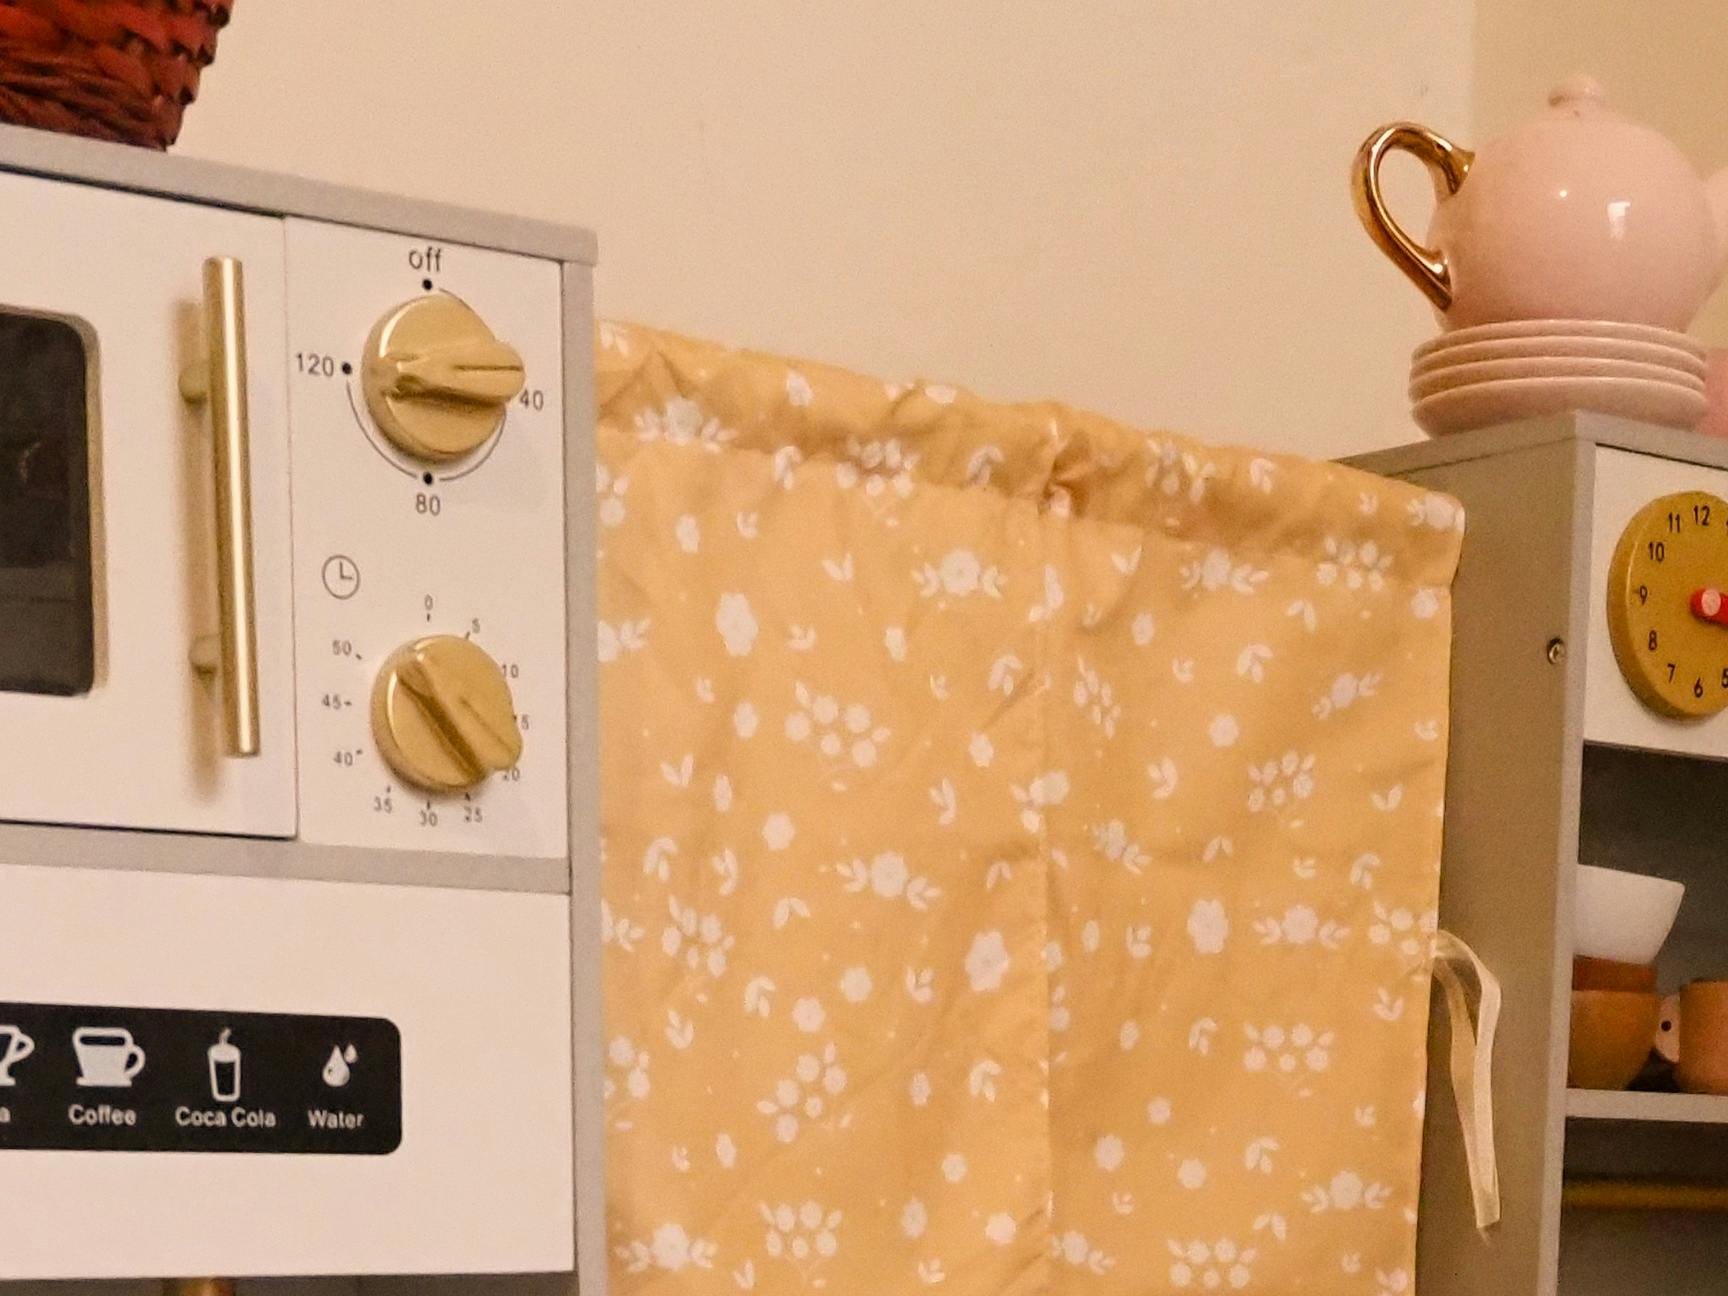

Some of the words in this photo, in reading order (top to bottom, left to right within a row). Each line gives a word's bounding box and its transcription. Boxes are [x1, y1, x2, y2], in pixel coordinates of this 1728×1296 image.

[296, 352, 335, 378] 120
[519, 389, 545, 411] 40
[415, 493, 441, 516] 80
[1668, 512, 1681, 534] 11
[1693, 504, 1711, 527] 12
[1648, 541, 1665, 563] 10
[424, 595, 434, 611] 0
[1639, 585, 1648, 605] 9
[471, 618, 481, 634] 5
[1648, 630, 1658, 651] 8
[1667, 663, 1676, 684] 7
[1694, 678, 1704, 698] 6
[322, 694, 342, 710] 45
[333, 751, 354, 767] 40
[373, 796, 393, 814] 35
[419, 810, 438, 827] 30
[67, 1103, 137, 1126] Coffee
[175, 1105, 227, 1127] Coca
[230, 1106, 277, 1128] Cola
[307, 1109, 365, 1130] Water
